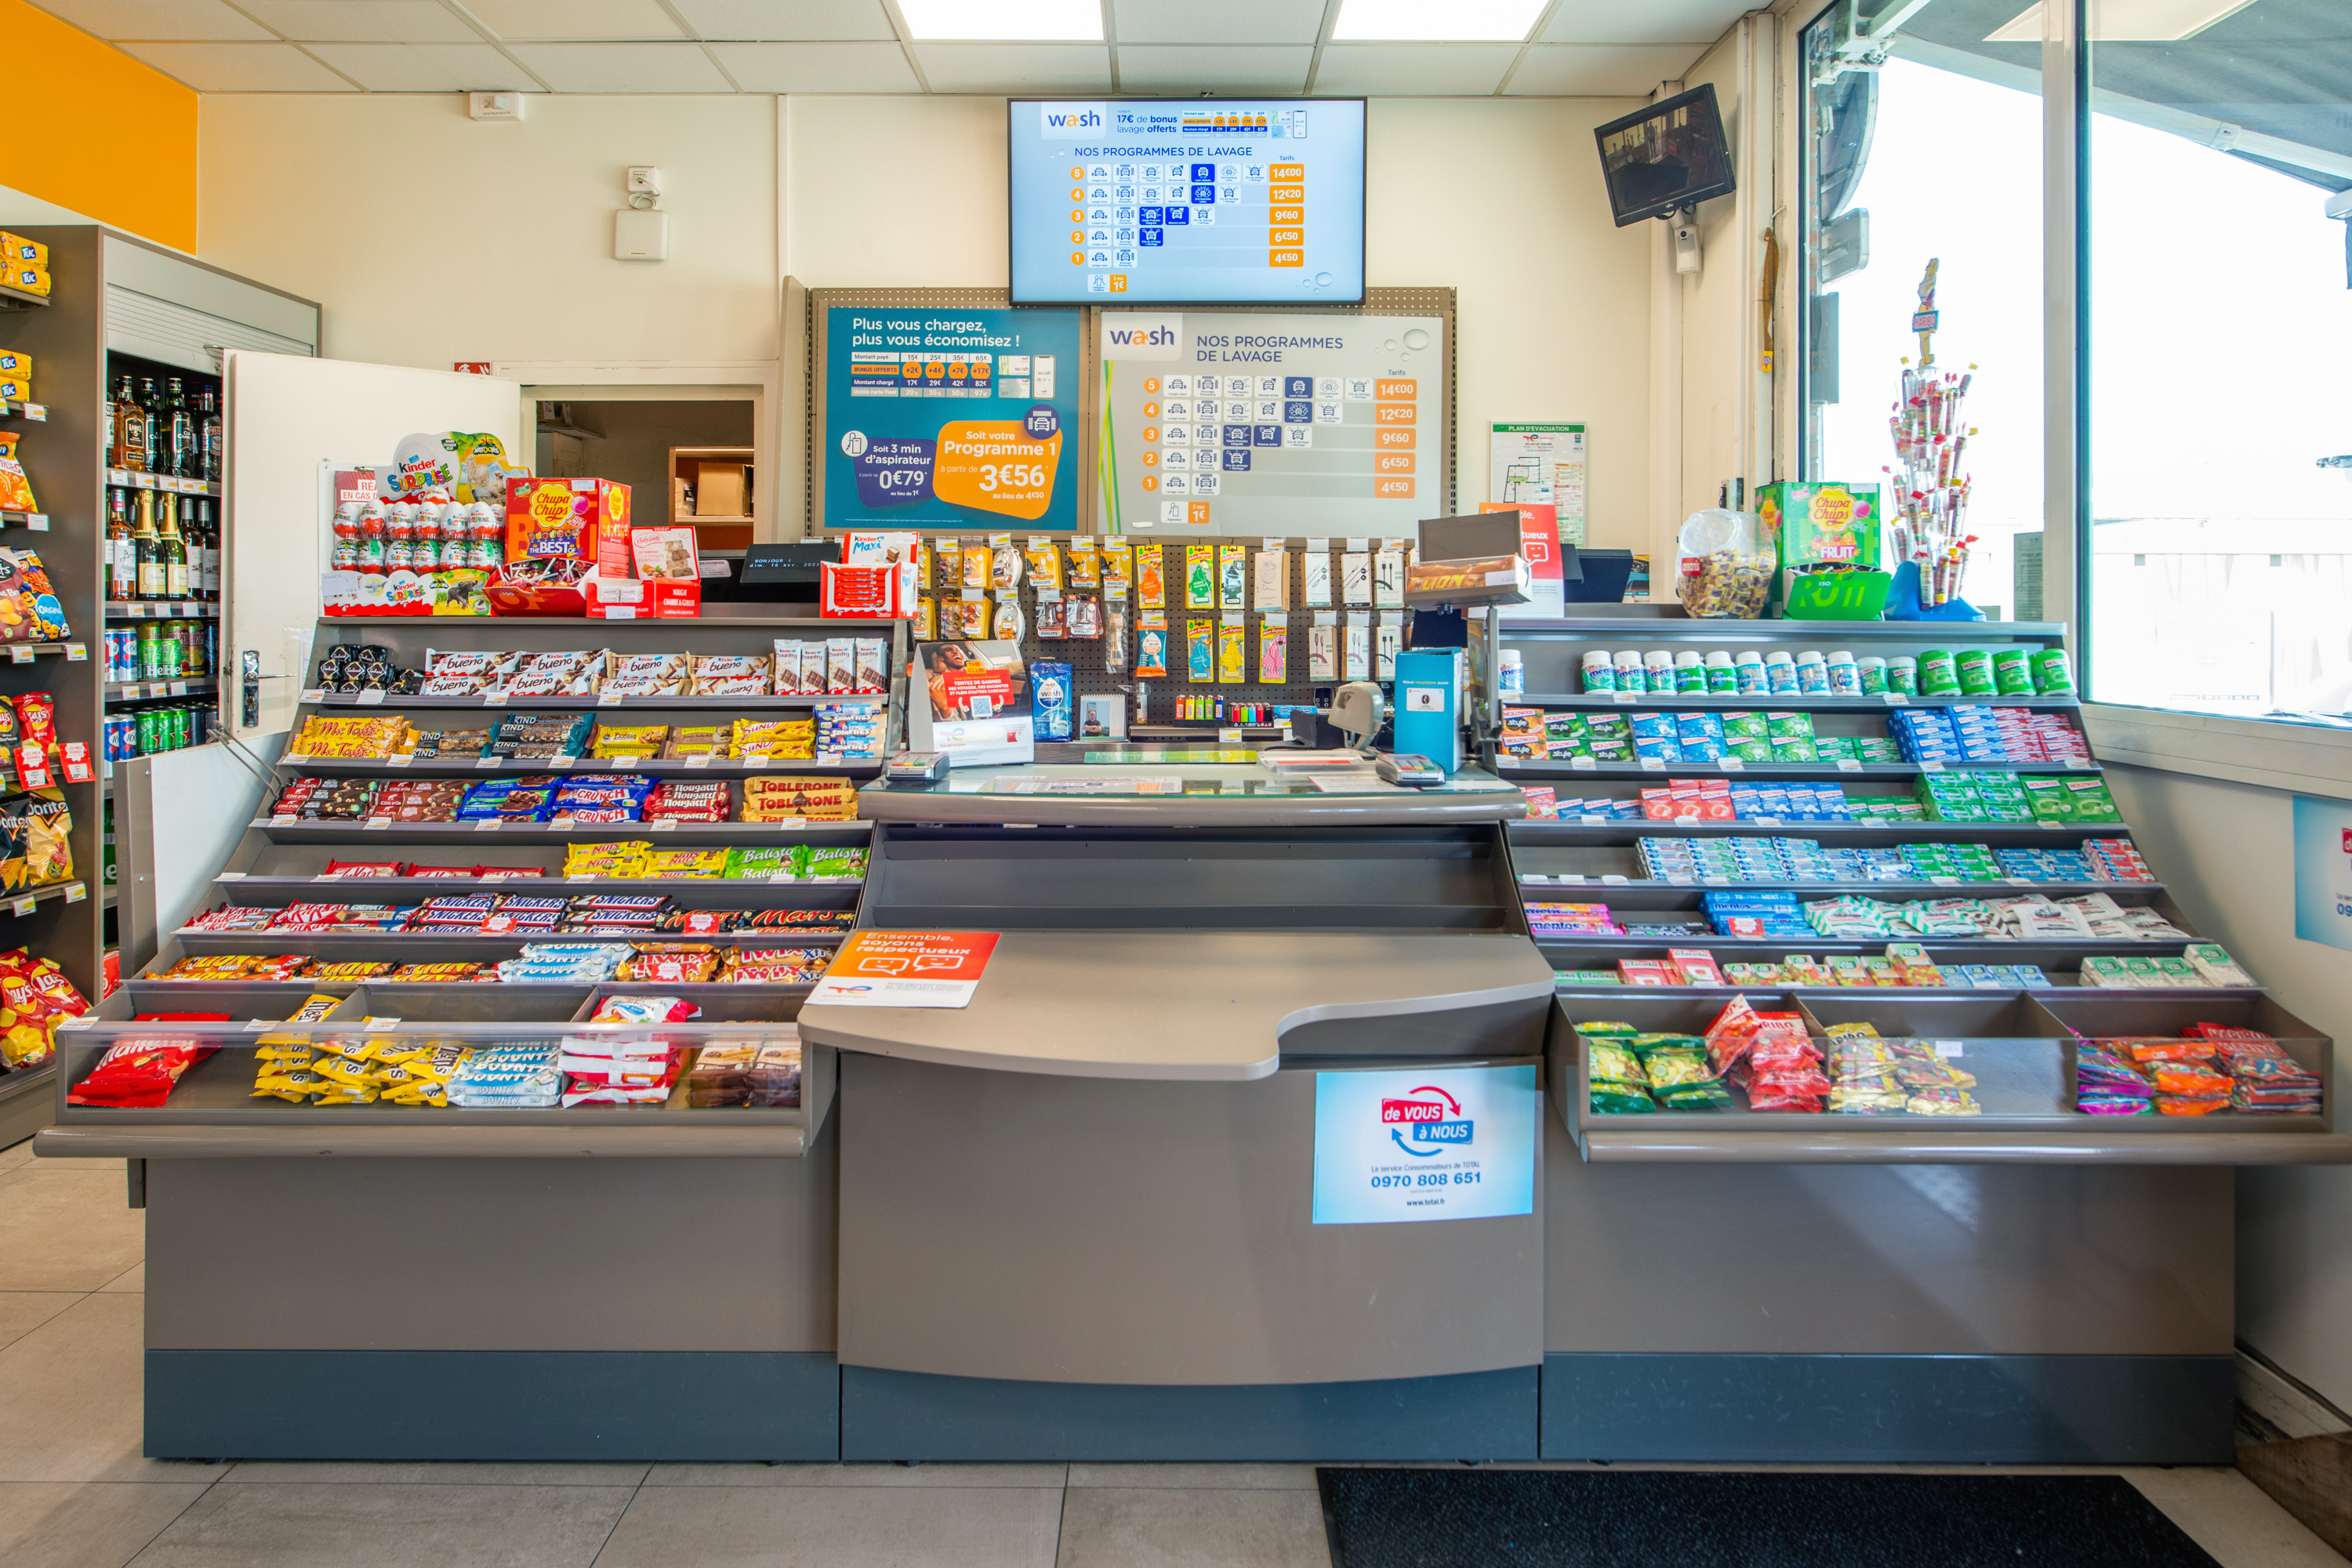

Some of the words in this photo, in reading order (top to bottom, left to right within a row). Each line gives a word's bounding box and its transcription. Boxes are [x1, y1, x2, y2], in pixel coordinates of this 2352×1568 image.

[1047, 110, 1100, 127] wash
[1075, 147, 1099, 156] NOS
[1103, 147, 1185, 156] PROGRAMMES
[1189, 147, 1203, 156] DE
[1207, 147, 1252, 156] LAVAGE
[1273, 168, 1301, 179] 14€00
[1273, 189, 1301, 200] 12€20
[1275, 211, 1298, 221] 9€60
[1275, 230, 1298, 242] 6€50
[1274, 252, 1298, 264] 4€50
[853, 318, 882, 329] Plus
[887, 321, 920, 330] vous
[925, 319, 986, 333] chargez,
[1915, 314, 1936, 328] HARIBO
[853, 333, 882, 347] plus
[887, 336, 920, 345] vous
[925, 334, 1011, 347] économisez
[1016, 336, 1019, 347] !
[1110, 325, 1174, 345] wash
[1197, 336, 1229, 347] NOS
[1235, 336, 1343, 348] PROGRAMMES
[1197, 350, 1217, 361] DE
[1223, 350, 1282, 362] LAVAGE
[1380, 384, 1414, 395] 14€00
[1380, 409, 1413, 419] 12€20
[129, 424, 142, 433] LABEL
[1382, 433, 1410, 445] 9€60
[945, 441, 1044, 457] Programme
[1049, 443, 1055, 456] 1
[1382, 457, 1409, 468] 6€50
[387, 463, 453, 492] SURPRISE
[1381, 481, 1409, 493] 4€50
[536, 493, 568, 505] Chupa
[1816, 498, 1850, 509] Chupa
[534, 504, 568, 521] Chups
[1813, 507, 1849, 525] Chups
[539, 542, 568, 554] BEST
[853, 542, 881, 554] Maxi
[1821, 546, 1855, 558] FRUIT
[1422, 575, 1466, 590] LION
[447, 659, 483, 669] bueno
[539, 659, 572, 670] bueno
[346, 722, 376, 735] Tom
[675, 784, 718, 793] Nougatti
[760, 780, 841, 792] TOBLERONE
[578, 789, 625, 803] CRUNCH
[743, 848, 794, 863] Balisto
[434, 897, 494, 909] SNICKERS
[752, 910, 833, 926] Mars
[866, 933, 954, 942] Ensemble,
[856, 946, 971, 955] respectueux
[198, 956, 252, 968] LION
[1384, 1107, 1401, 1120] de
[1404, 1105, 1441, 1120] VOUS
[1419, 1126, 1427, 1140] à
[1431, 1124, 1468, 1138] NOUS
[1404, 1163, 1452, 1171] Consommateurs
[1371, 1176, 1411, 1188] 0970
[1417, 1174, 1448, 1185] 808
[1454, 1172, 1481, 1184] 651
[1406, 1198, 1446, 1207] www.total.fr
